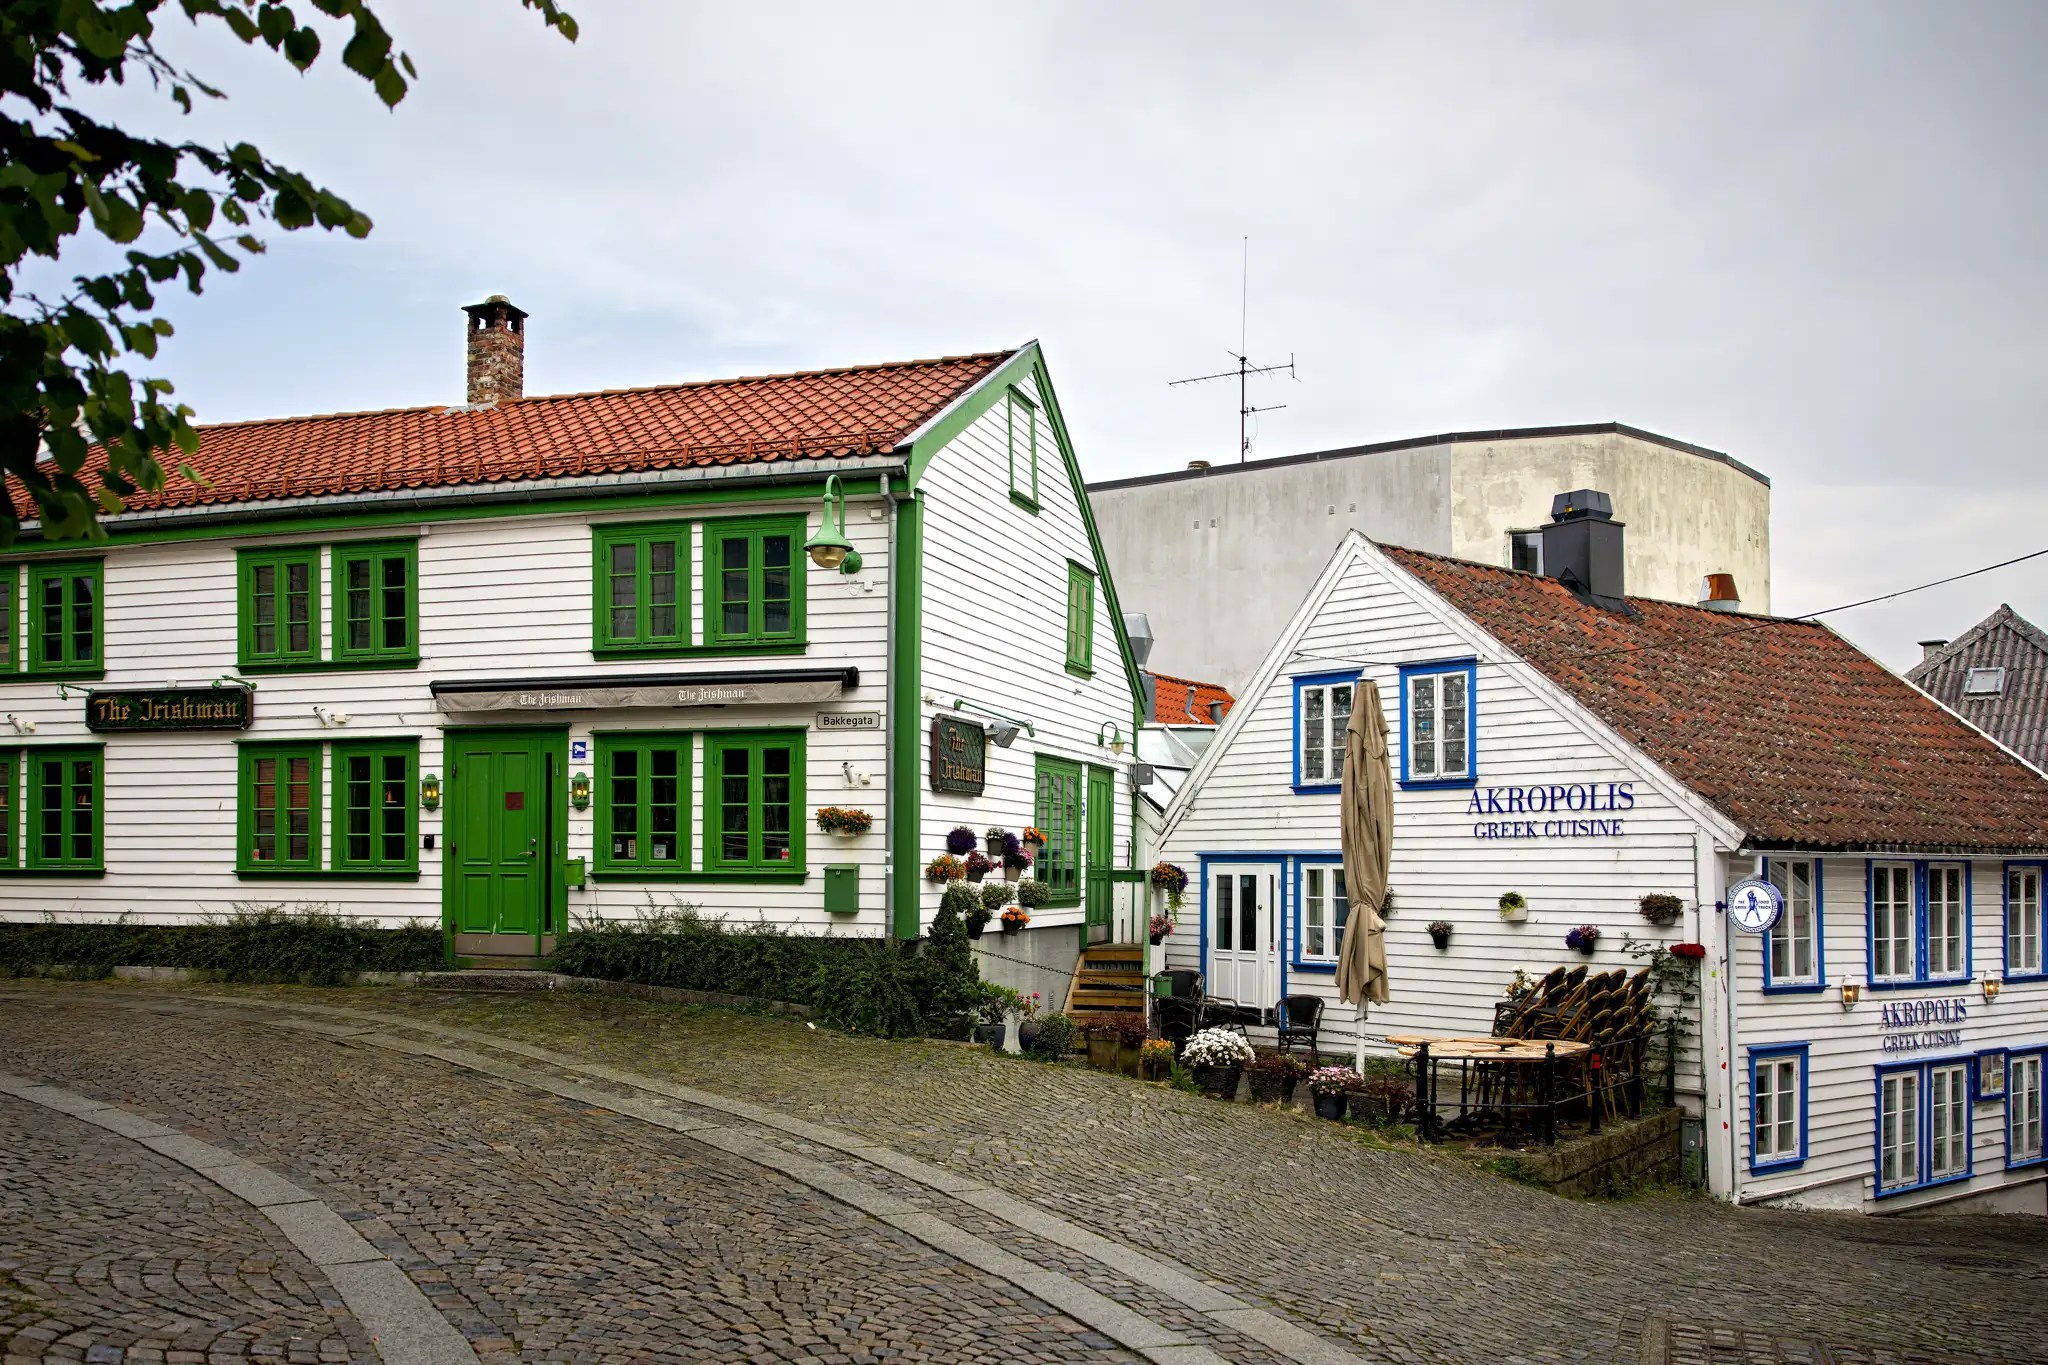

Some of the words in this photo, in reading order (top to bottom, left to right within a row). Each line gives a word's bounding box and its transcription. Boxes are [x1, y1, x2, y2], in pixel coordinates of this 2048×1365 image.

[519, 693, 537, 706] The
[538, 692, 582, 707] Irishman
[679, 689, 697, 701] The
[699, 687, 745, 701] Irishman
[94, 695, 131, 722] The
[139, 696, 239, 722] Irishman
[823, 715, 873, 727] Bakkegata
[948, 726, 969, 752] The
[941, 756, 983, 784] Irishman
[1466, 782, 1635, 815] AKROPOLIS
[1473, 820, 1539, 840] GREEK
[1544, 818, 1625, 839] CUISINE
[1880, 997, 1967, 1029] AKROPOLIS
[1883, 1033, 1921, 1053] GREEK
[1922, 1029, 1964, 1050] CUISINE
